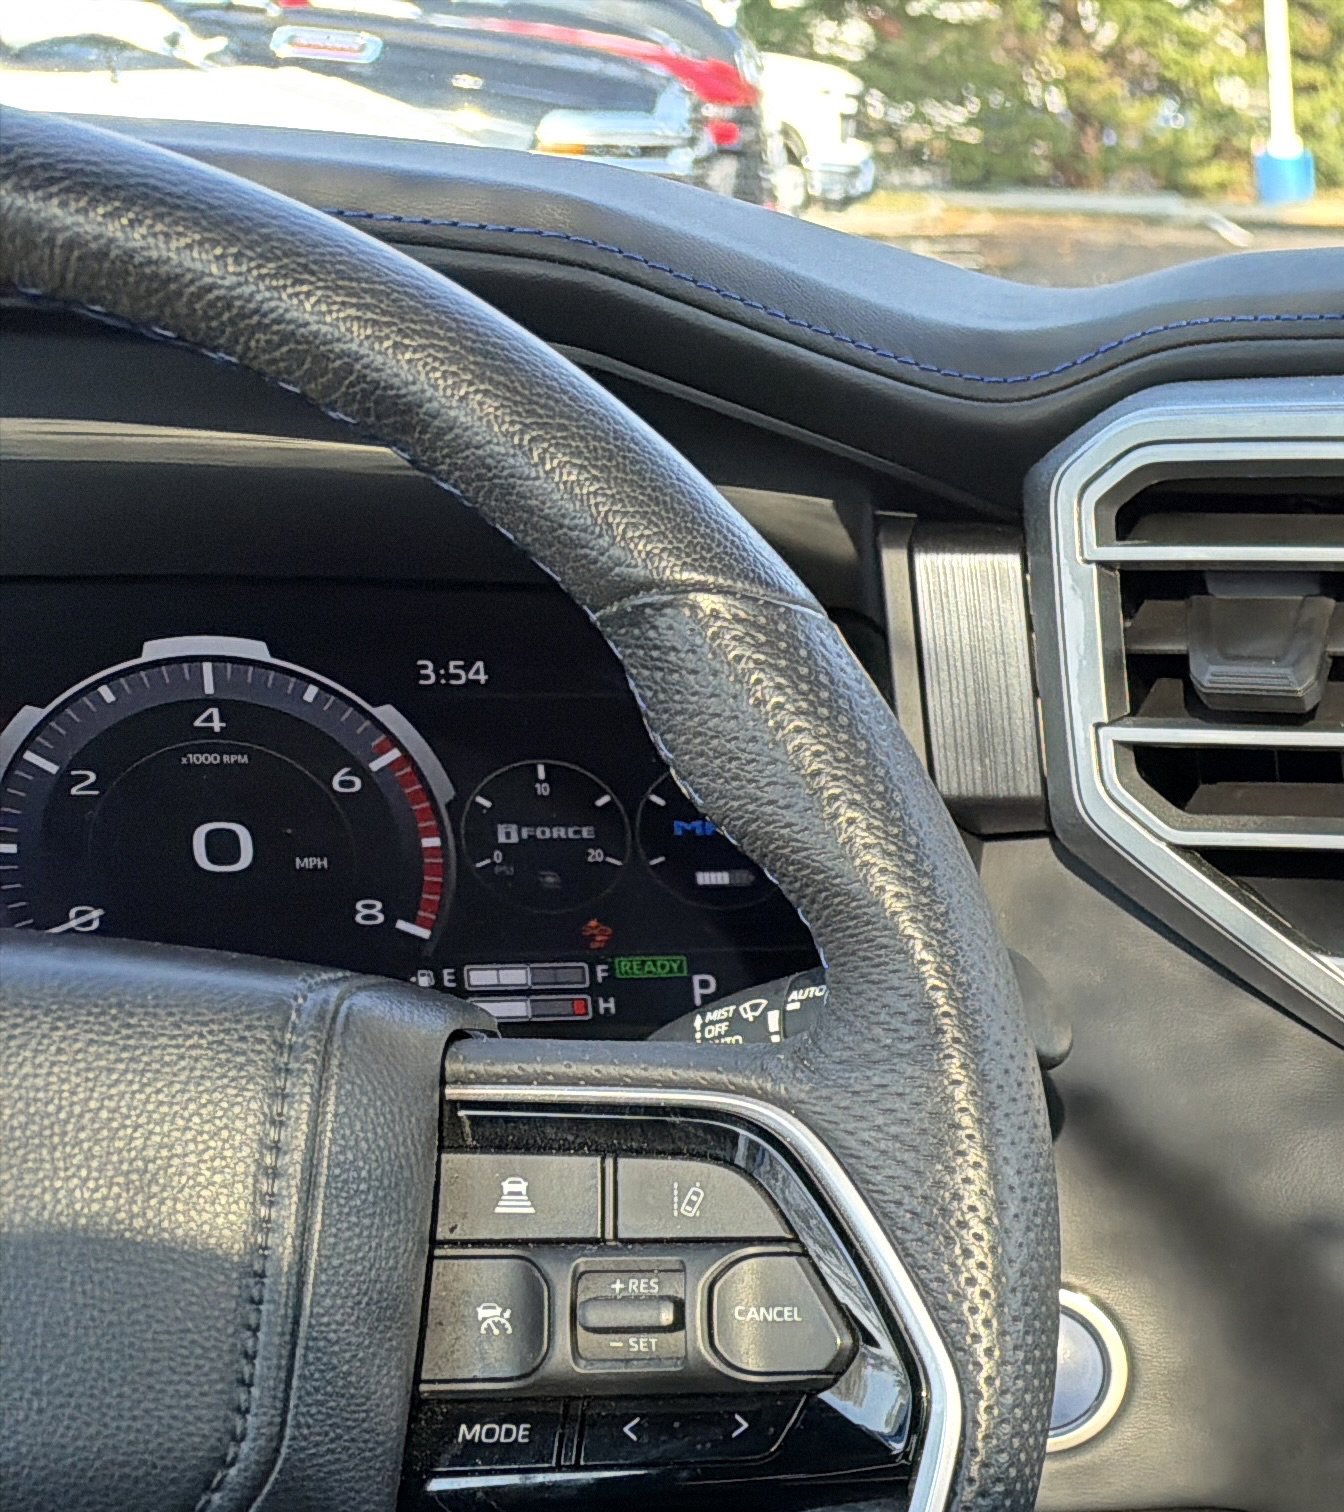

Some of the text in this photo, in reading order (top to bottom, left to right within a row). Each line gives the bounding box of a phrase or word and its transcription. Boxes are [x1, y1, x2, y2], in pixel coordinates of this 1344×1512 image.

[416, 660, 489, 687] 3:54
[193, 707, 226, 733] 4
[223, 754, 249, 764] RPM
[70, 770, 100, 795] 2
[332, 768, 362, 795] 6
[535, 782, 550, 796] 10
[192, 821, 253, 872] 0
[587, 848, 604, 862] 20
[295, 857, 328, 869] MPH
[355, 900, 385, 926] 8
[618, 960, 683, 975] READY
[442, 967, 610, 988] E F
[692, 974, 717, 1006] P
[788, 985, 827, 1002] AUTO
[600, 998, 616, 1014] H
[705, 1005, 737, 1023] MIST
[704, 1022, 730, 1038] OFF
[734, 1305, 802, 1323] CANCEL
[457, 1422, 531, 1444] MODE
